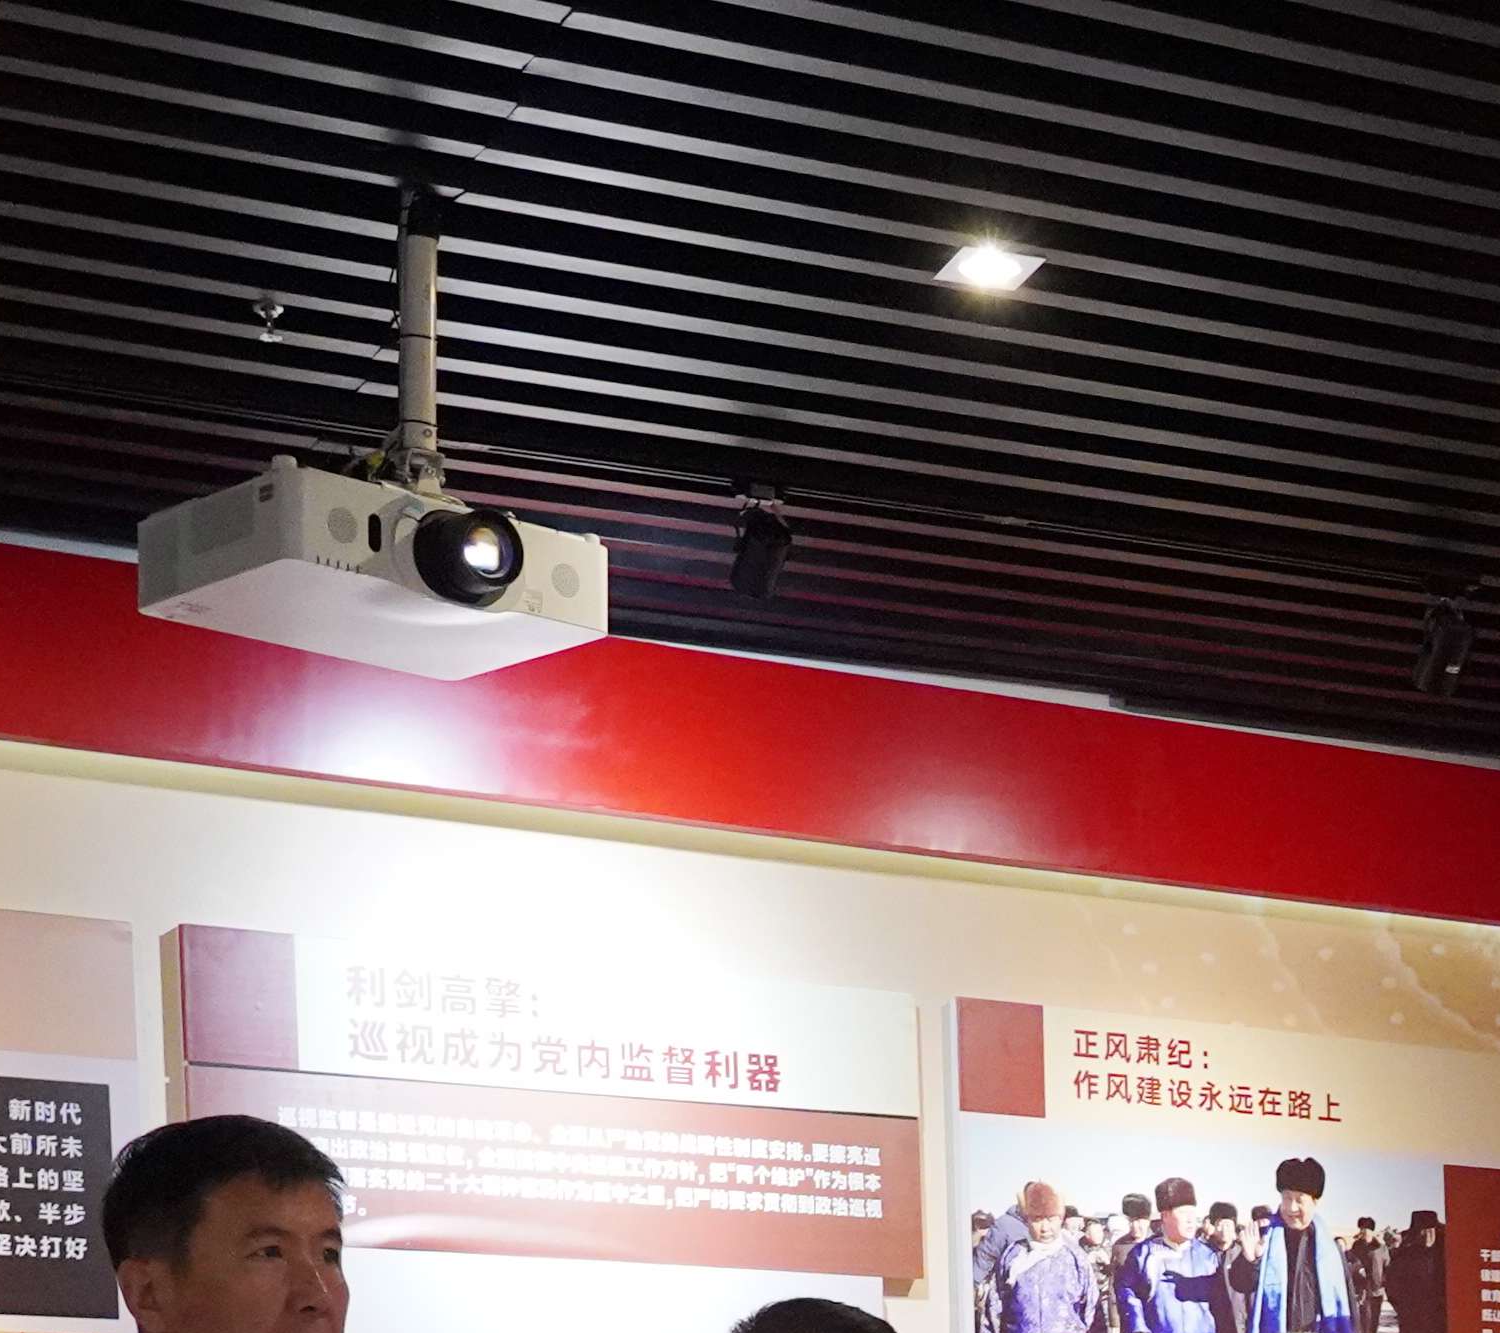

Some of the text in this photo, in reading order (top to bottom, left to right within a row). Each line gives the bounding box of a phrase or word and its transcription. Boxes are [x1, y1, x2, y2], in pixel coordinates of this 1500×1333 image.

[347, 1017, 782, 1093] 巡视成为党内监督利器
[1073, 1069, 1342, 1123] 作风建设永远在路上
